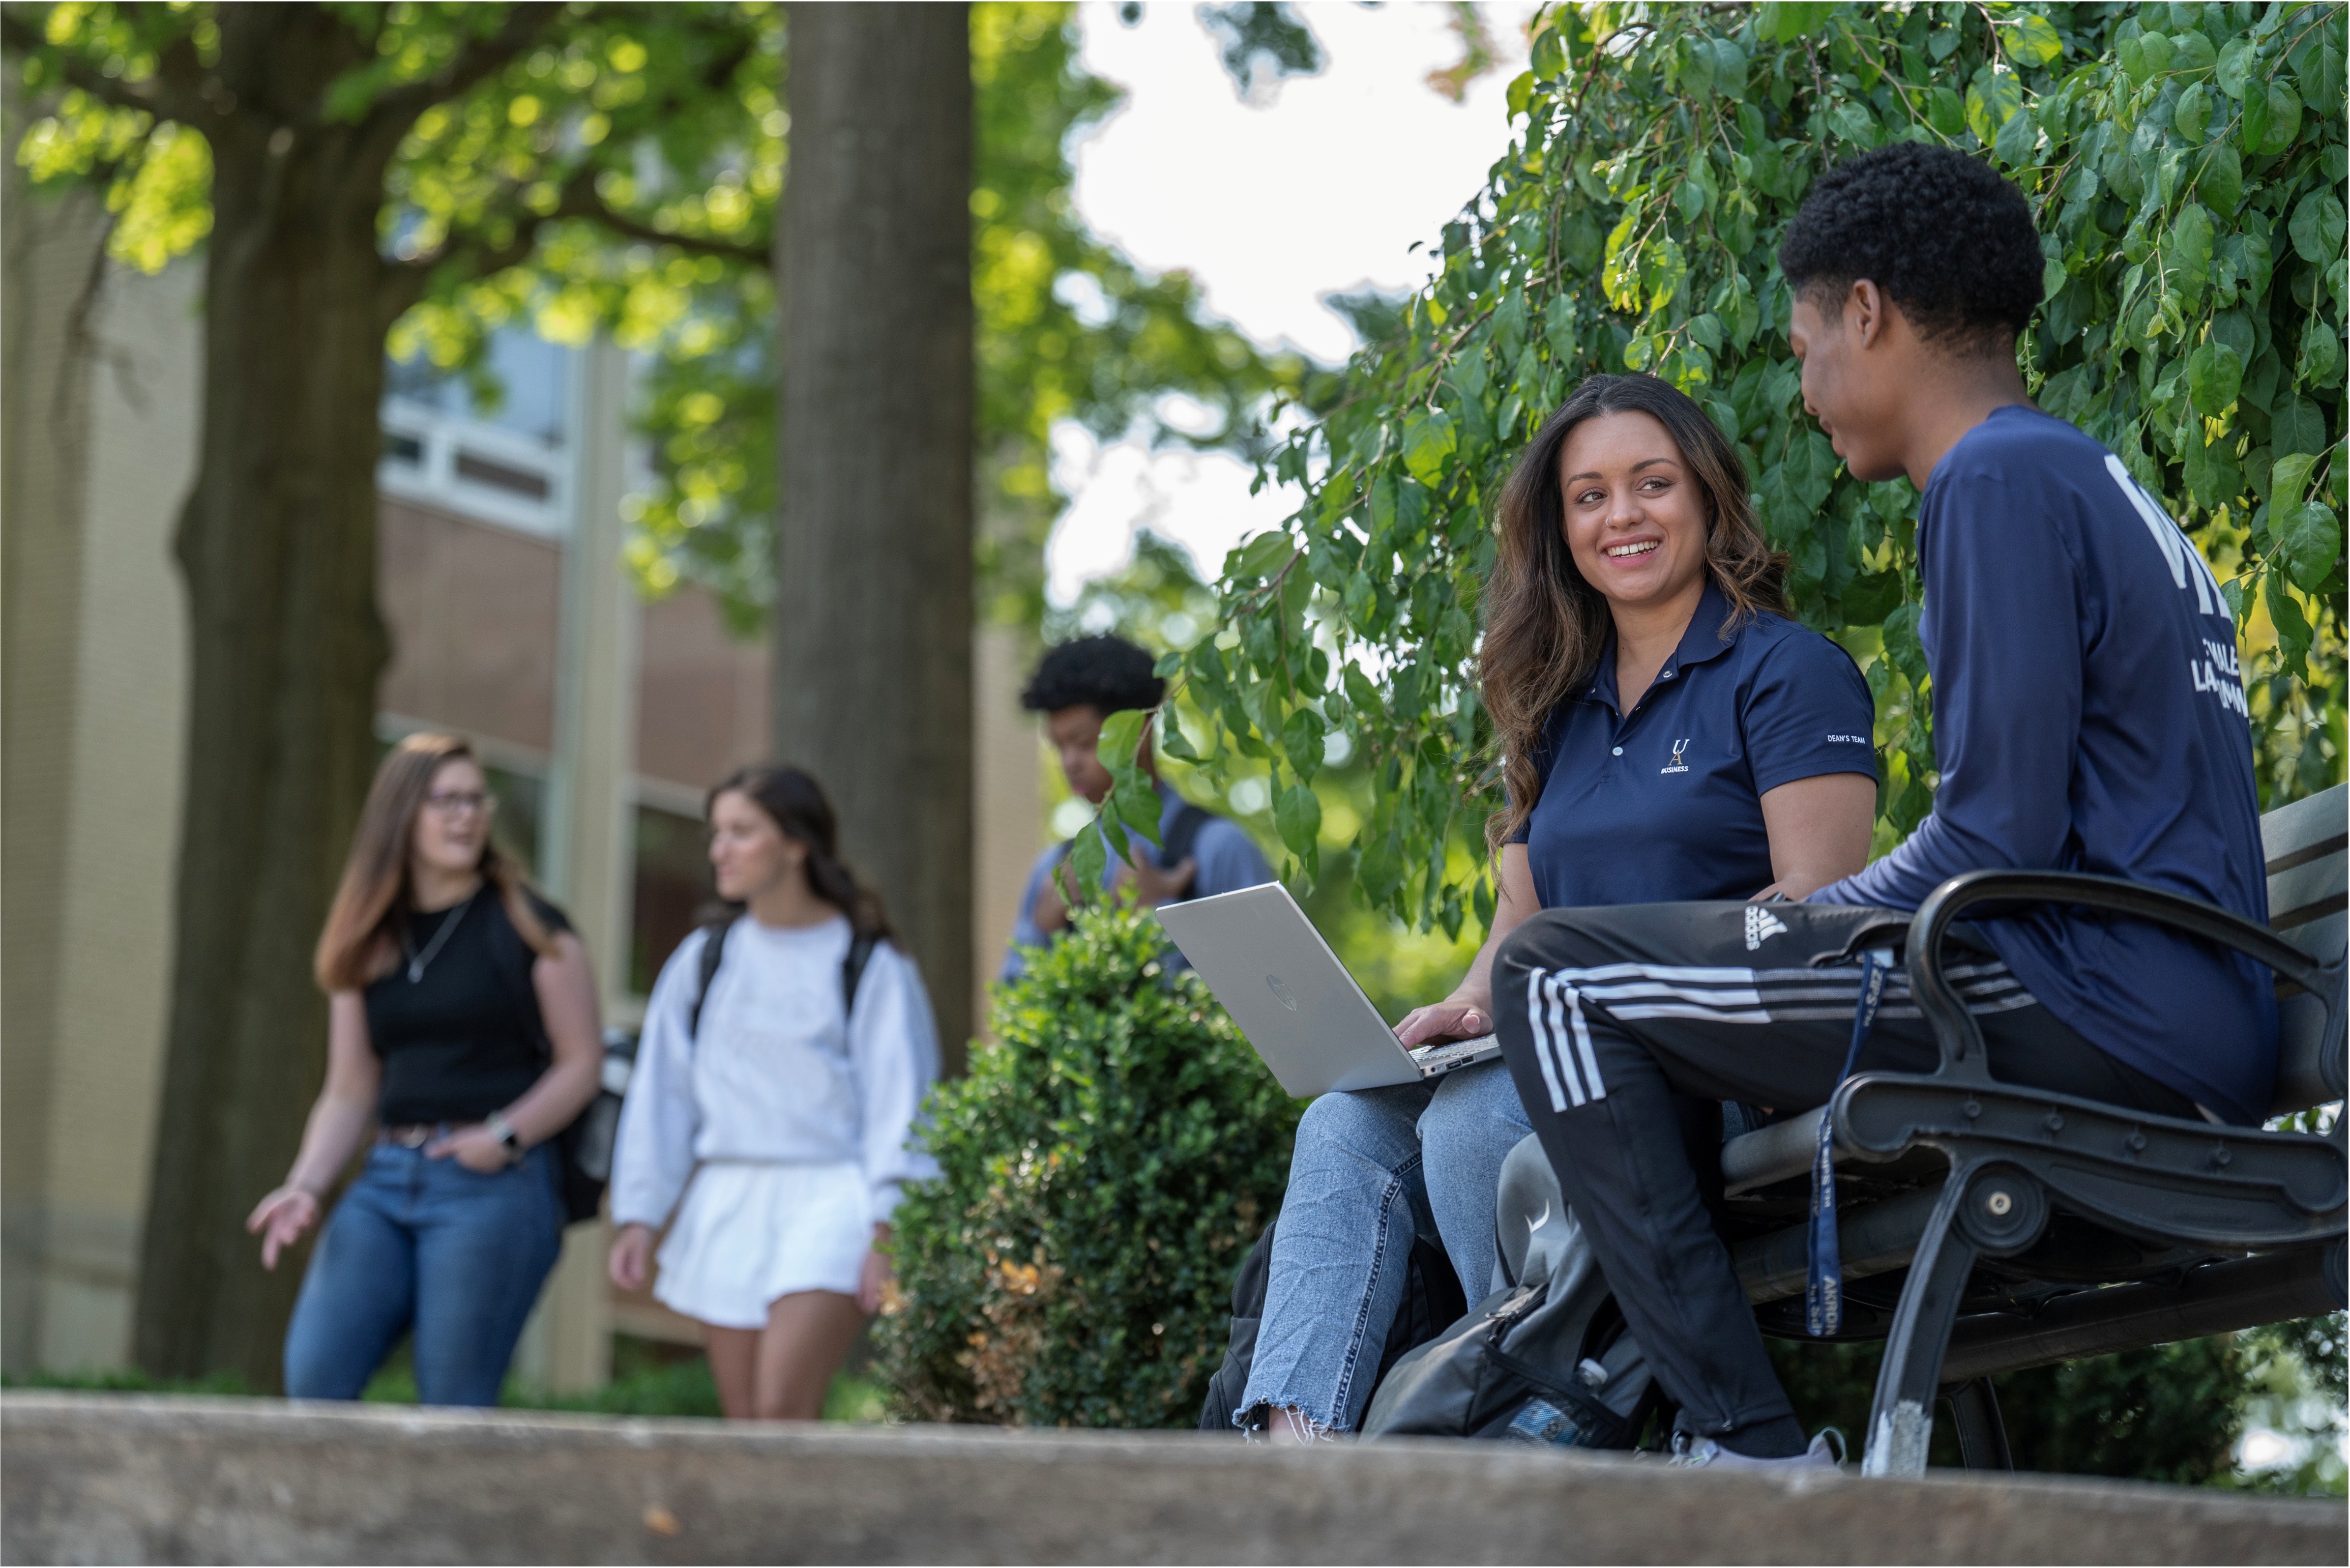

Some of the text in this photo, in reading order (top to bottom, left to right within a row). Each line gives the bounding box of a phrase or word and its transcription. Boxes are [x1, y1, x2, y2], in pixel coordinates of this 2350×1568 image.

[1851, 735, 1866, 744] TEAM
[1660, 765, 1689, 774] BUSINESS
[1744, 905, 1761, 951] adidas
[1823, 1275, 1839, 1336] AKRON
